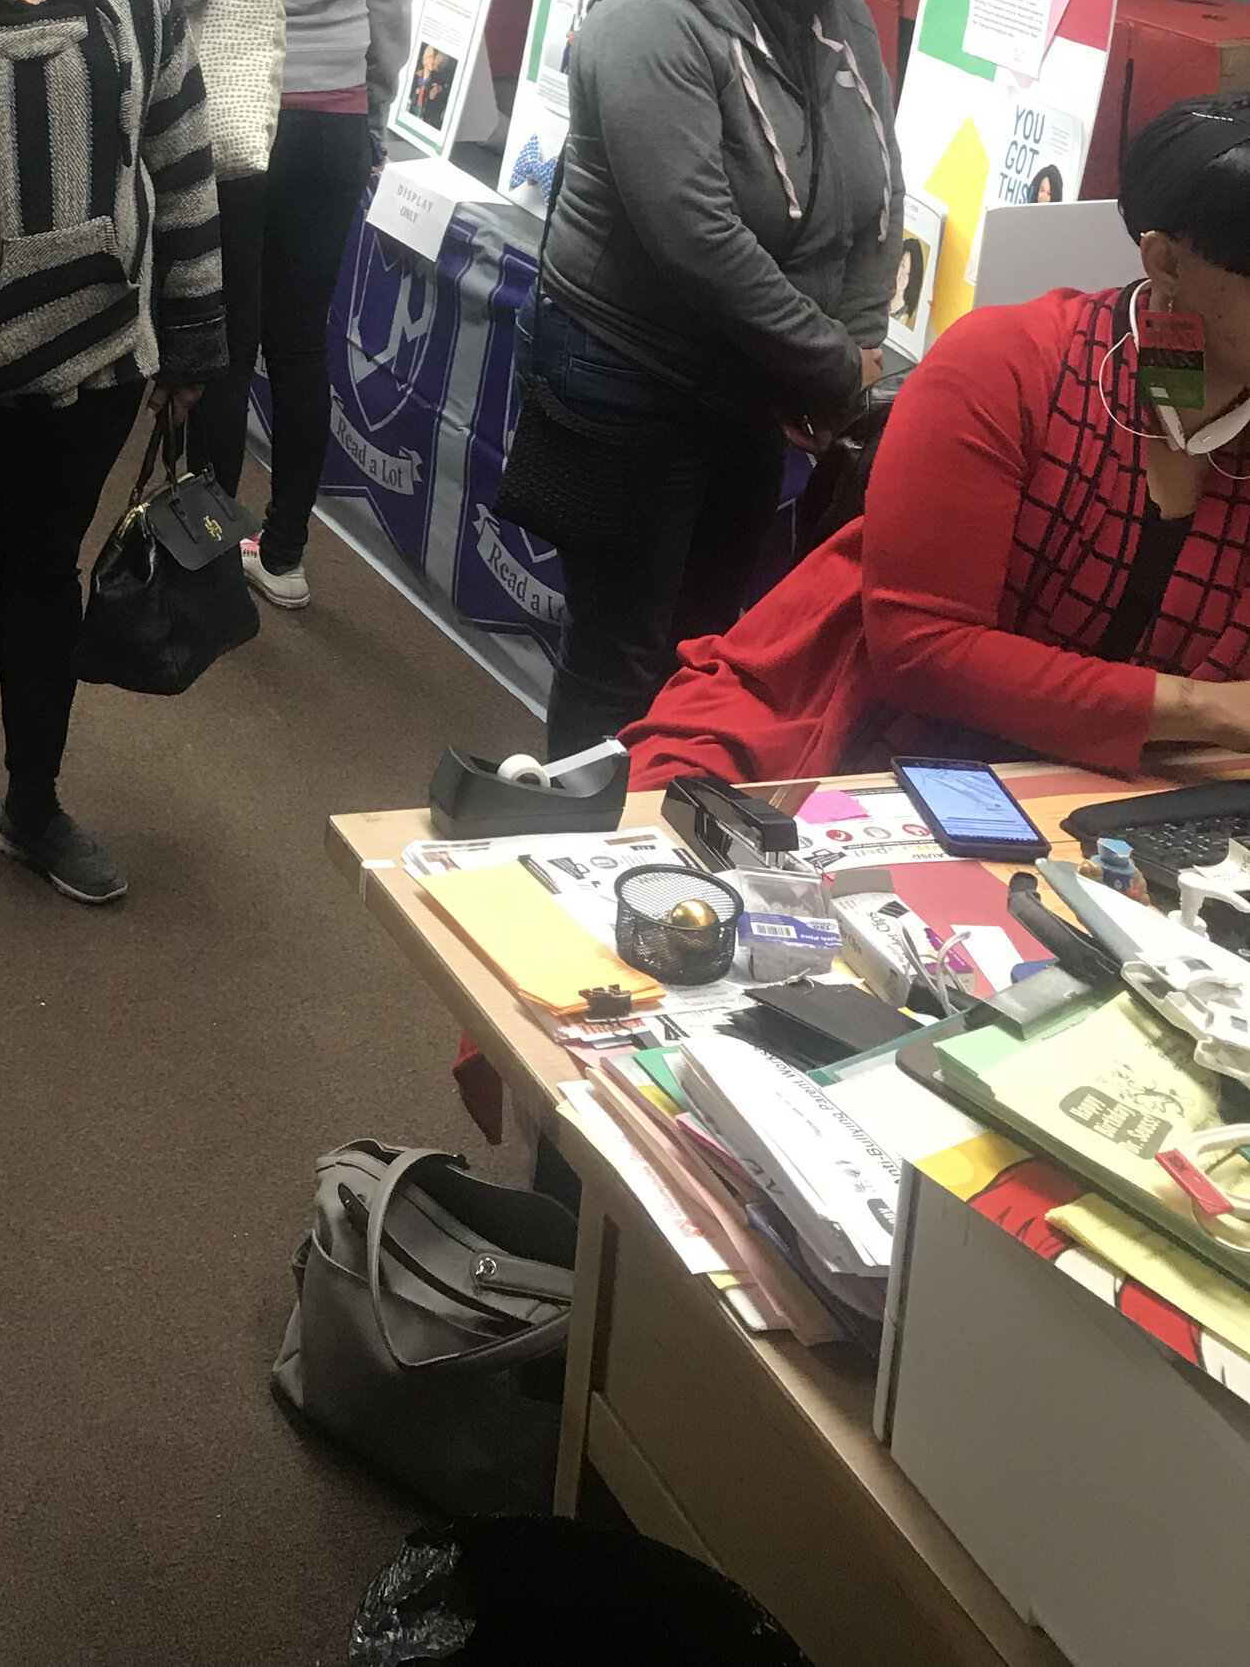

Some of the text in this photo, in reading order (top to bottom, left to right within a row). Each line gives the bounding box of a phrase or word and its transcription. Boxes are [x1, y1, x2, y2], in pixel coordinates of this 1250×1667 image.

[1013, 104, 1046, 145] YOU
[1004, 140, 1040, 180] GOT
[396, 184, 435, 213] DISPLAY
[399, 205, 421, 224] ONLY
[336, 417, 404, 489] Read a Lot
[487, 542, 530, 603] Read
[531, 596, 541, 614] a
[793, 1077, 835, 1111] Parent
[1069, 1092, 1107, 1122] Happy
[1092, 1101, 1138, 1140] Birthday
